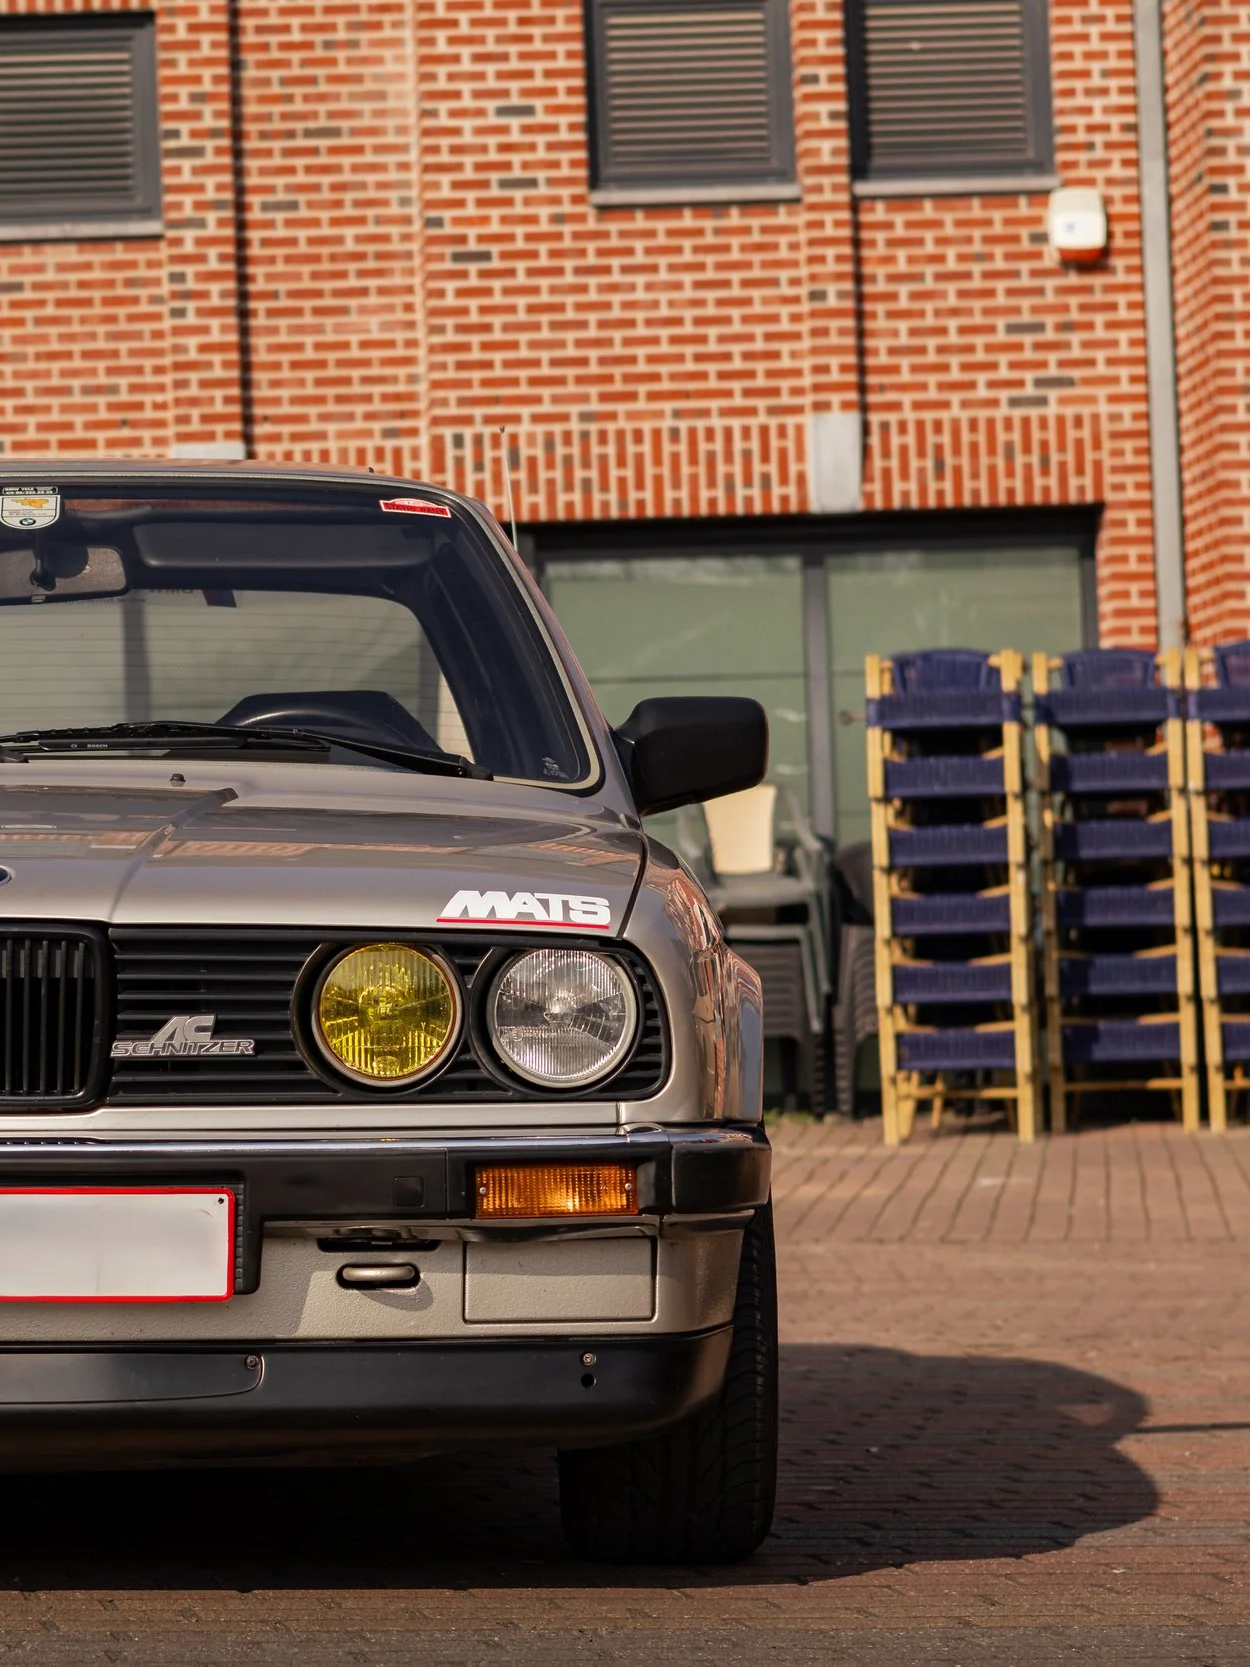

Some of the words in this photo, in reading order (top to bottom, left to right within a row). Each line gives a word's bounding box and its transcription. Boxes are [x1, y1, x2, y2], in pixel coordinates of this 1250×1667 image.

[439, 889, 611, 926] MATS
[150, 1015, 216, 1043] AC
[110, 1039, 256, 1057] SCHNITZER
